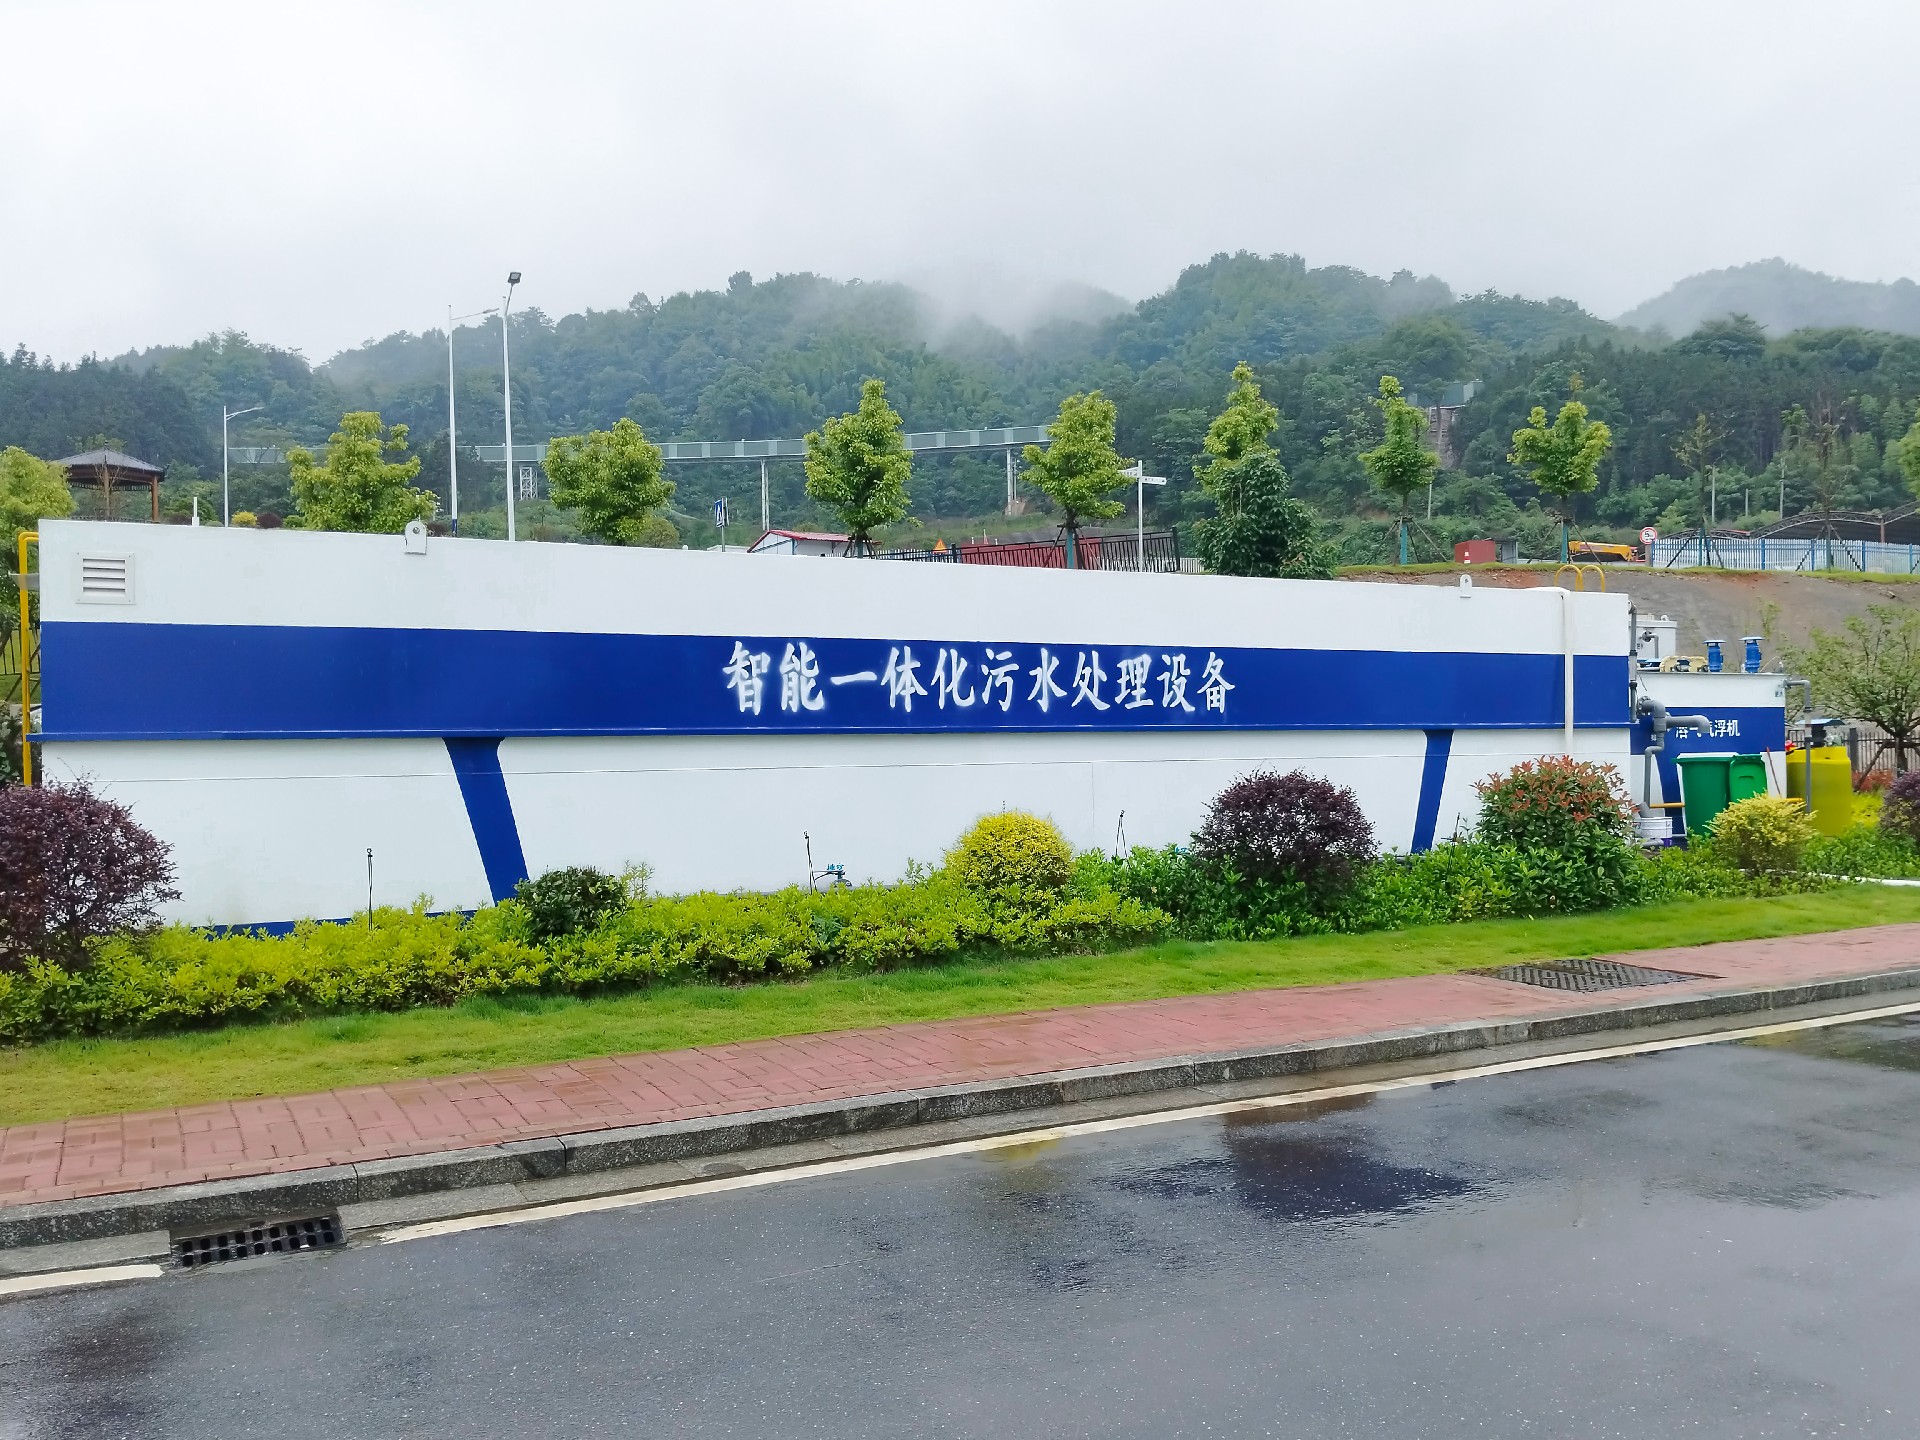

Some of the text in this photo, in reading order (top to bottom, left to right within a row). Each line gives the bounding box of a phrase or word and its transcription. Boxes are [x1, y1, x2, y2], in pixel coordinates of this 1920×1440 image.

[722, 640, 1236, 716] 智能一体化污水处理设备
